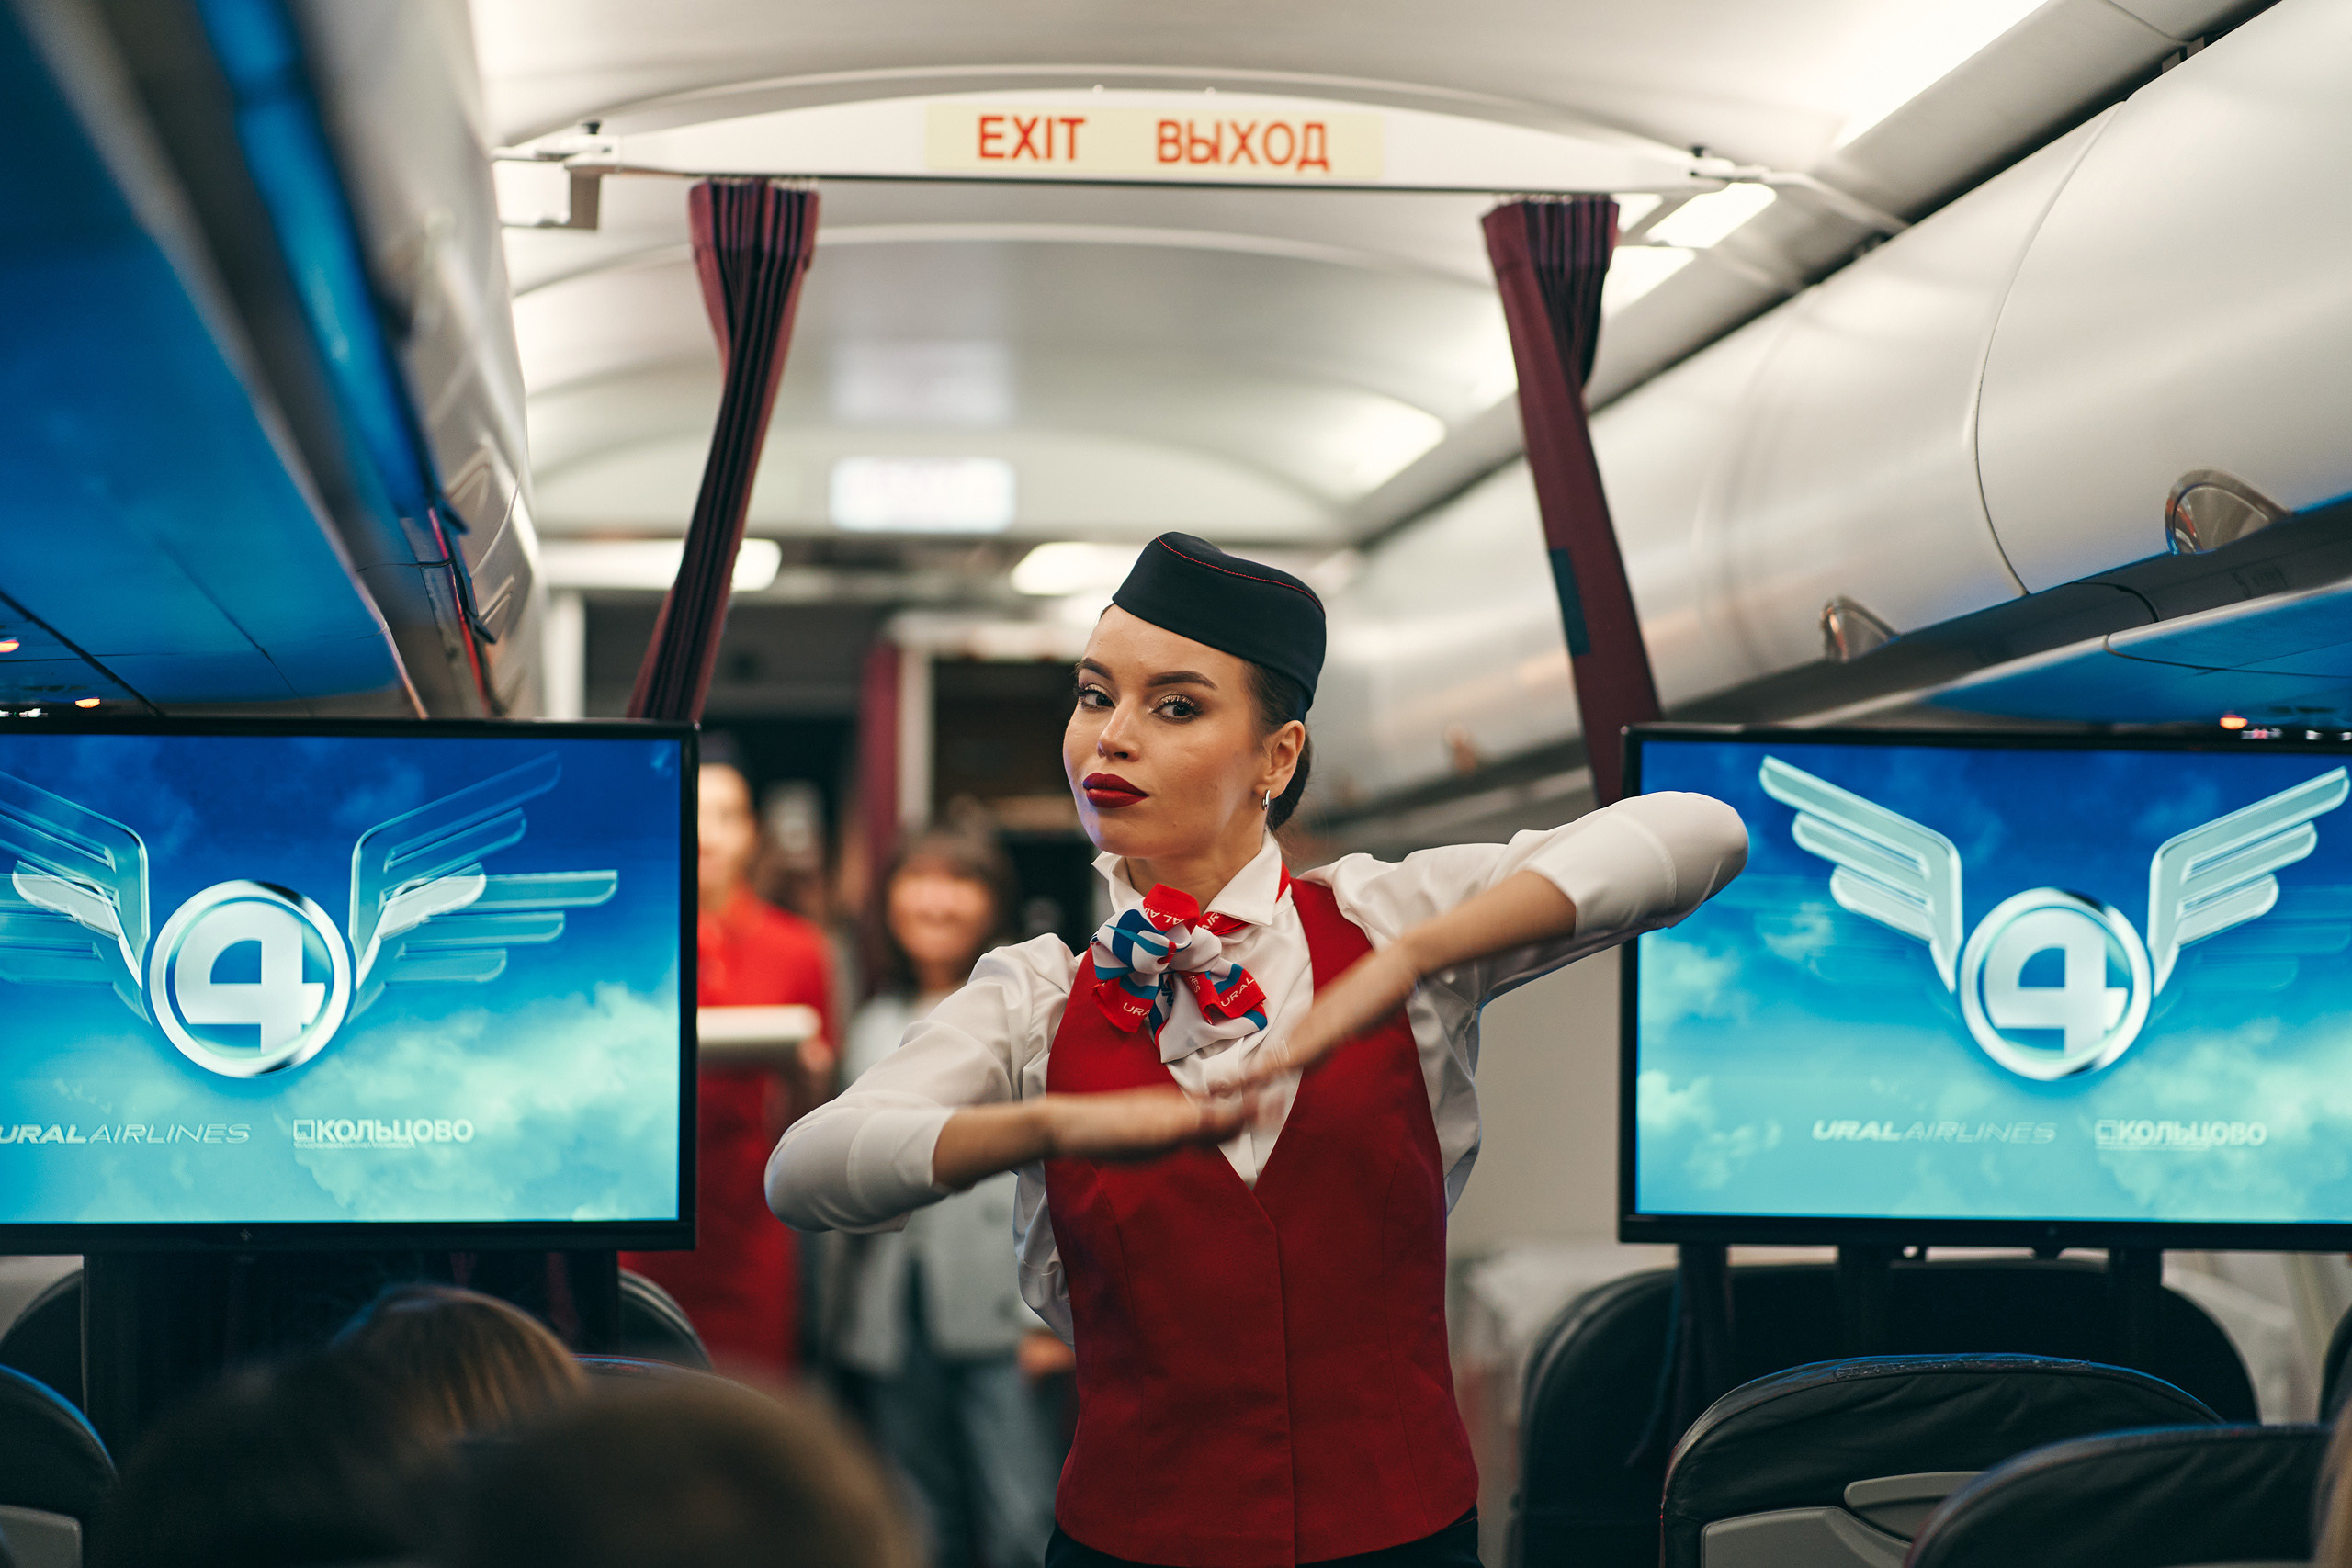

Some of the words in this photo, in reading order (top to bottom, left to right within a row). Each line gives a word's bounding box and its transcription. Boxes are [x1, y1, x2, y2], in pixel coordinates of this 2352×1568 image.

[978, 116, 1085, 161] EXIT
[1156, 119, 1330, 173] ВЫХОД
[1220, 977, 1255, 1007] URAL
[316, 1118, 475, 1145] КОЛЬЦОВО
[2118, 1118, 2267, 1148] КОЛЬЦОВО
